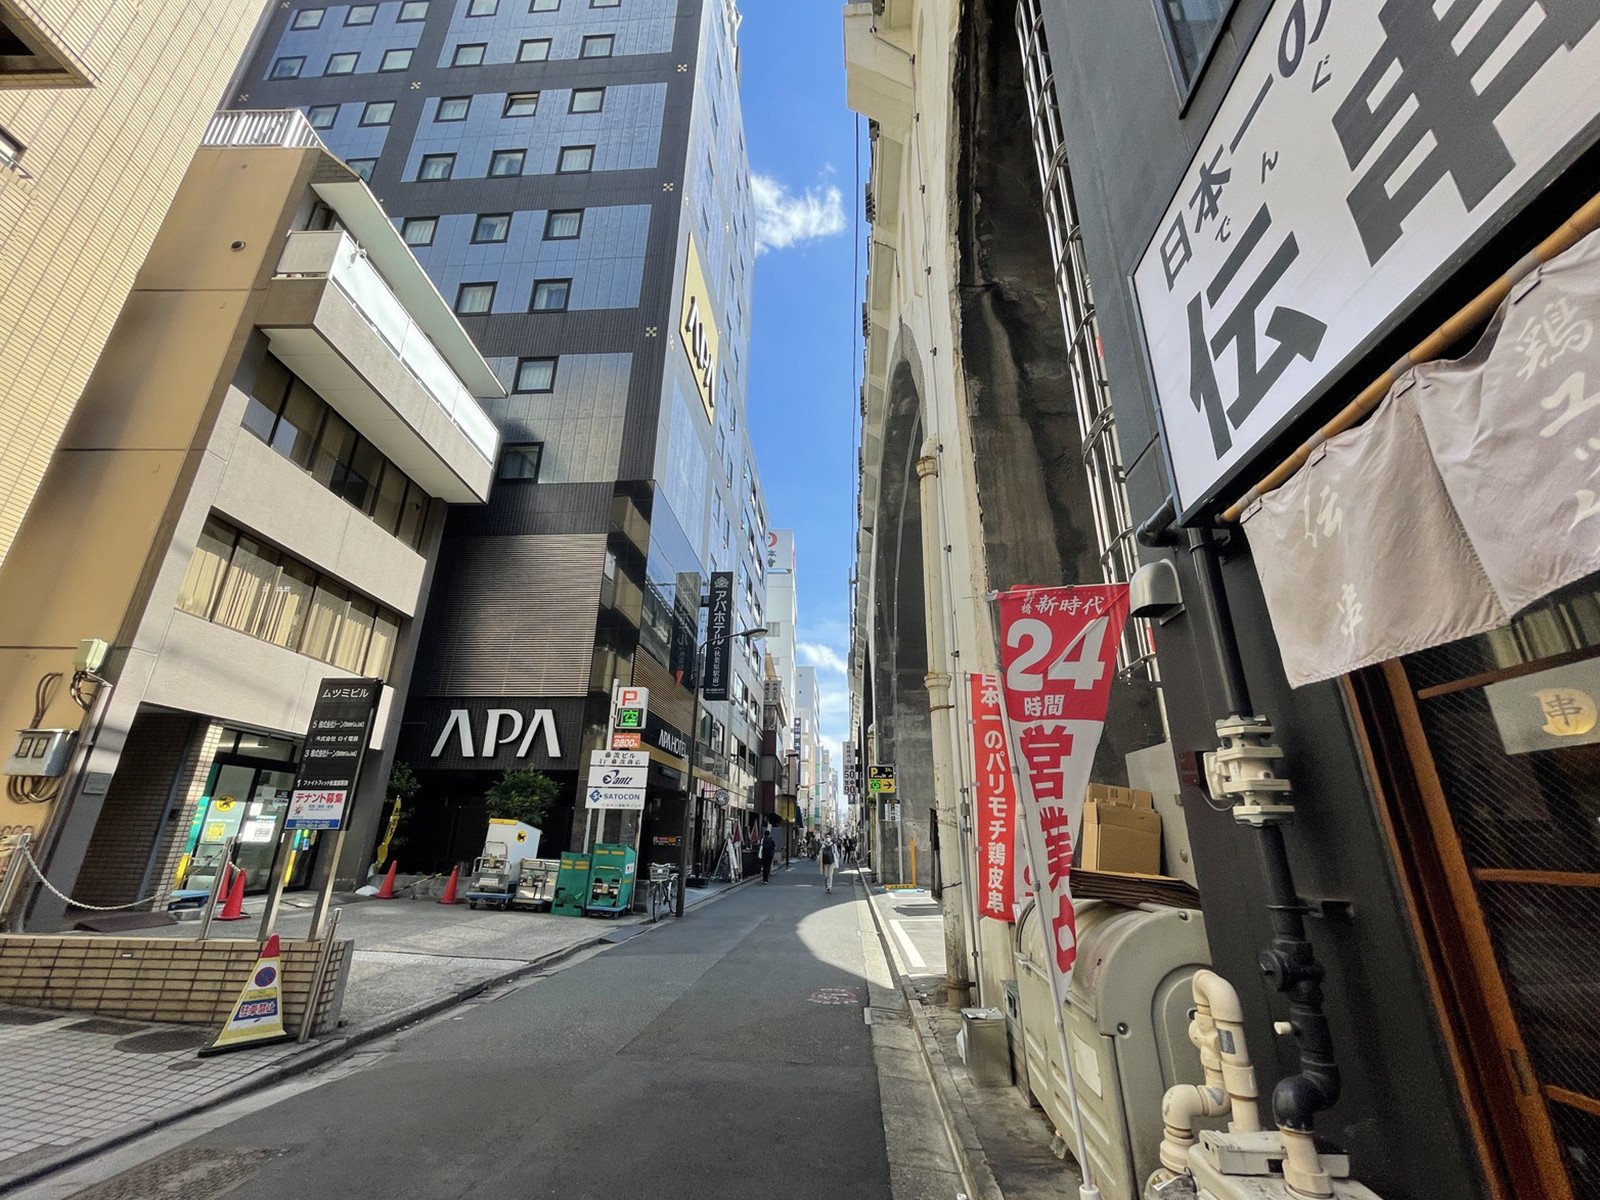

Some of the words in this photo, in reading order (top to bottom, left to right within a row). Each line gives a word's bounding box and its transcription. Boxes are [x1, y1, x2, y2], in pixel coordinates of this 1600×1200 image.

[1160, 0, 1331, 292] 日本一の
[1035, 594, 1105, 617] 新時代
[712, 590, 727, 646] アパホテル
[1006, 616, 1109, 691] 24
[322, 688, 369, 699] ムツミビル
[622, 691, 638, 706] P
[1023, 694, 1064, 717] 時間
[312, 720, 318, 729] 5
[620, 709, 639, 727] 空
[430, 709, 561, 758] APA
[304, 749, 309, 758] 3
[295, 792, 344, 804] テナント募集
[980, 674, 1008, 914] 日本一のパリモチ鶏皮串
